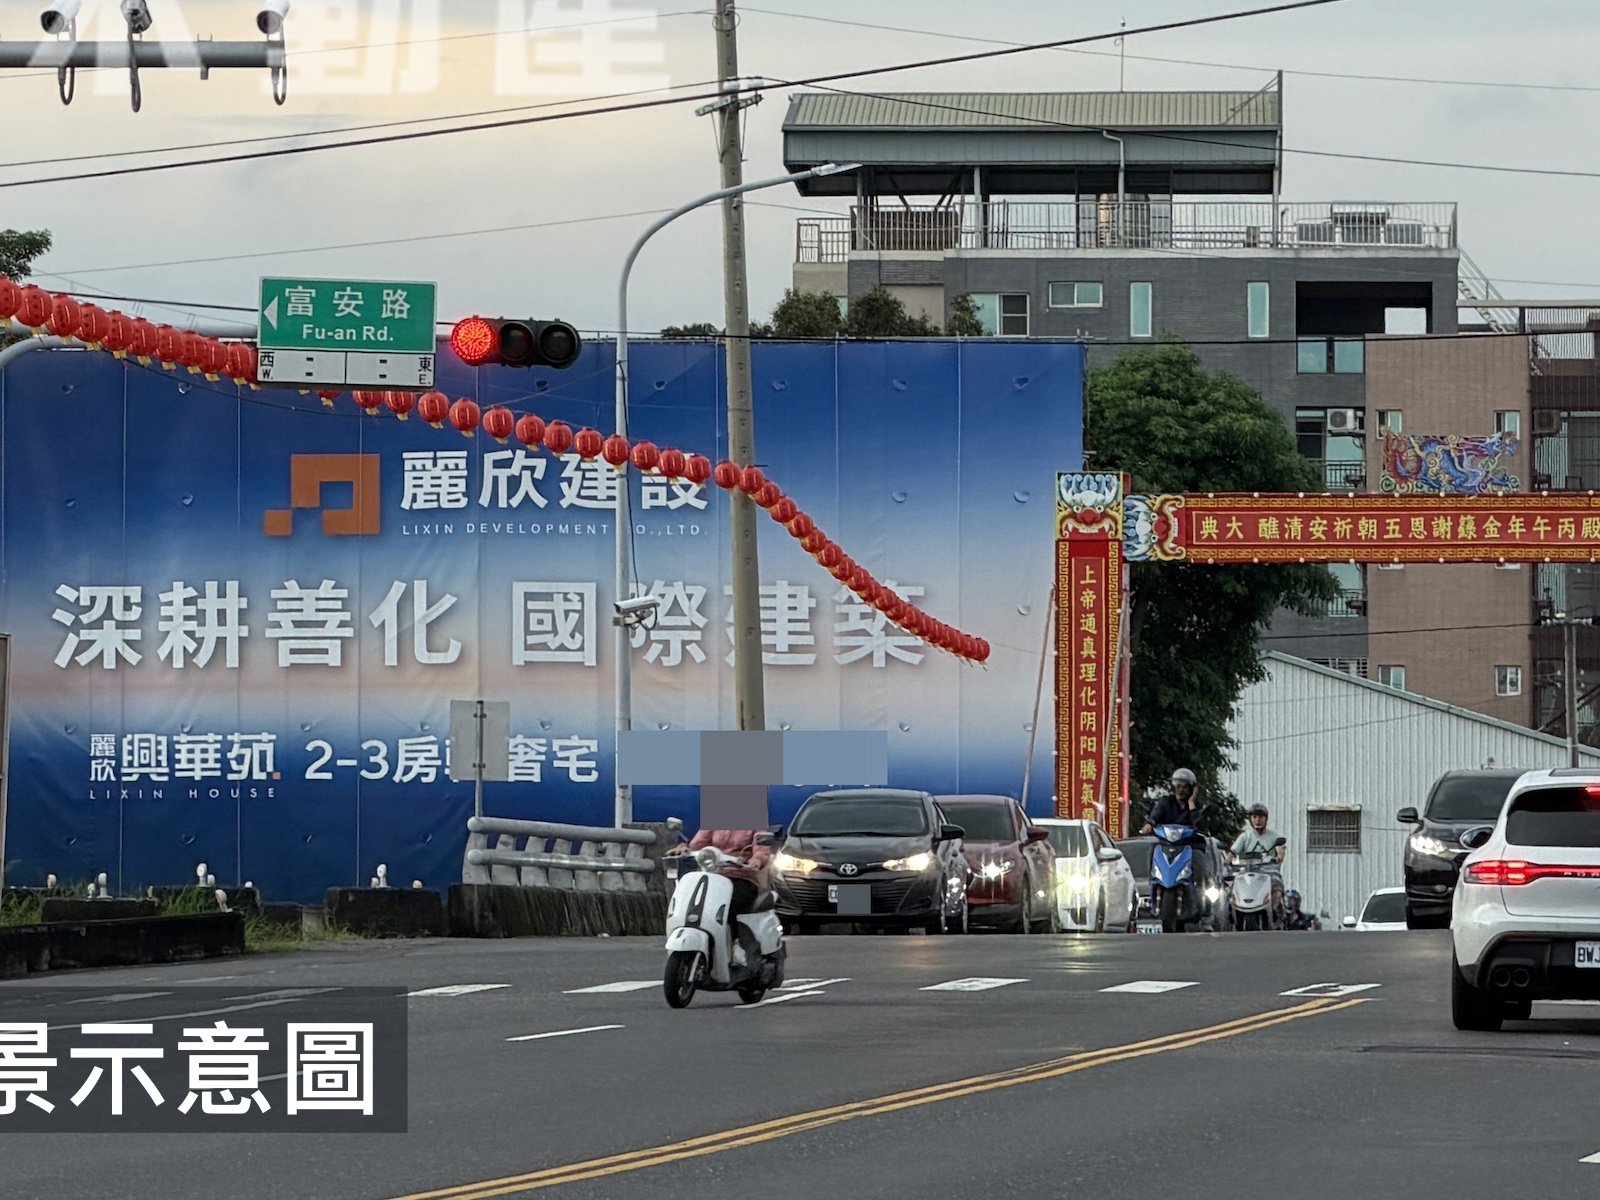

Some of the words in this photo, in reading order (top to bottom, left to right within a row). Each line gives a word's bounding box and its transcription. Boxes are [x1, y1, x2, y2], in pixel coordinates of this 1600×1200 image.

[284, 285, 411, 320] 富安路
[302, 324, 357, 340] Fu-an
[362, 325, 394, 342] Rd.
[260, 352, 274, 367] 西
[418, 357, 432, 372] 東
[400, 449, 708, 510] 麗欣建設
[402, 523, 454, 535] LIXIN
[466, 522, 609, 535] DEVELOPMENT
[627, 523, 708, 537] O.,LTD.
[51, 580, 462, 670] 深耕善化
[512, 579, 925, 668] 國際建築
[120, 733, 278, 782] 興華苑
[304, 736, 599, 783] 2-3房奢宅
[89, 788, 164, 800] LIXIN
[188, 787, 276, 799] HOUSE
